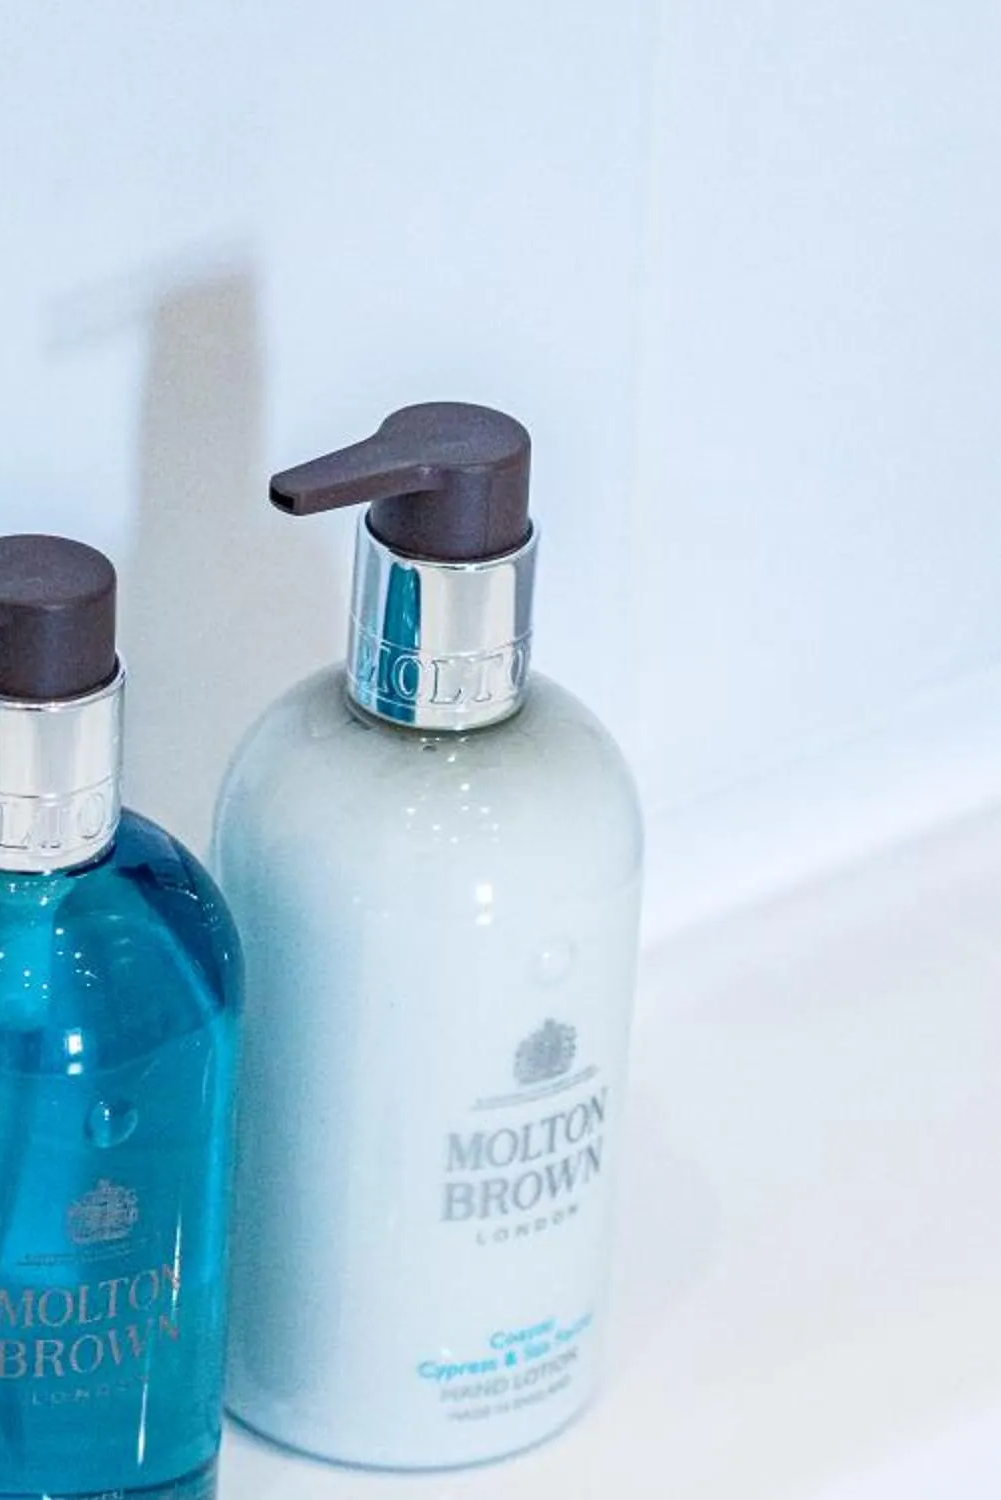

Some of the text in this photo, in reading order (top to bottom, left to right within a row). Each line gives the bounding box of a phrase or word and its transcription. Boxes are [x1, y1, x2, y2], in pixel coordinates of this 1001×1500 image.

[445, 1087, 609, 1172] MOLTON
[440, 1136, 603, 1222] BROWN
[476, 1203, 579, 1246] LONDON
[417, 1357, 498, 1382] Cypress
[440, 1377, 510, 1402] HAND
